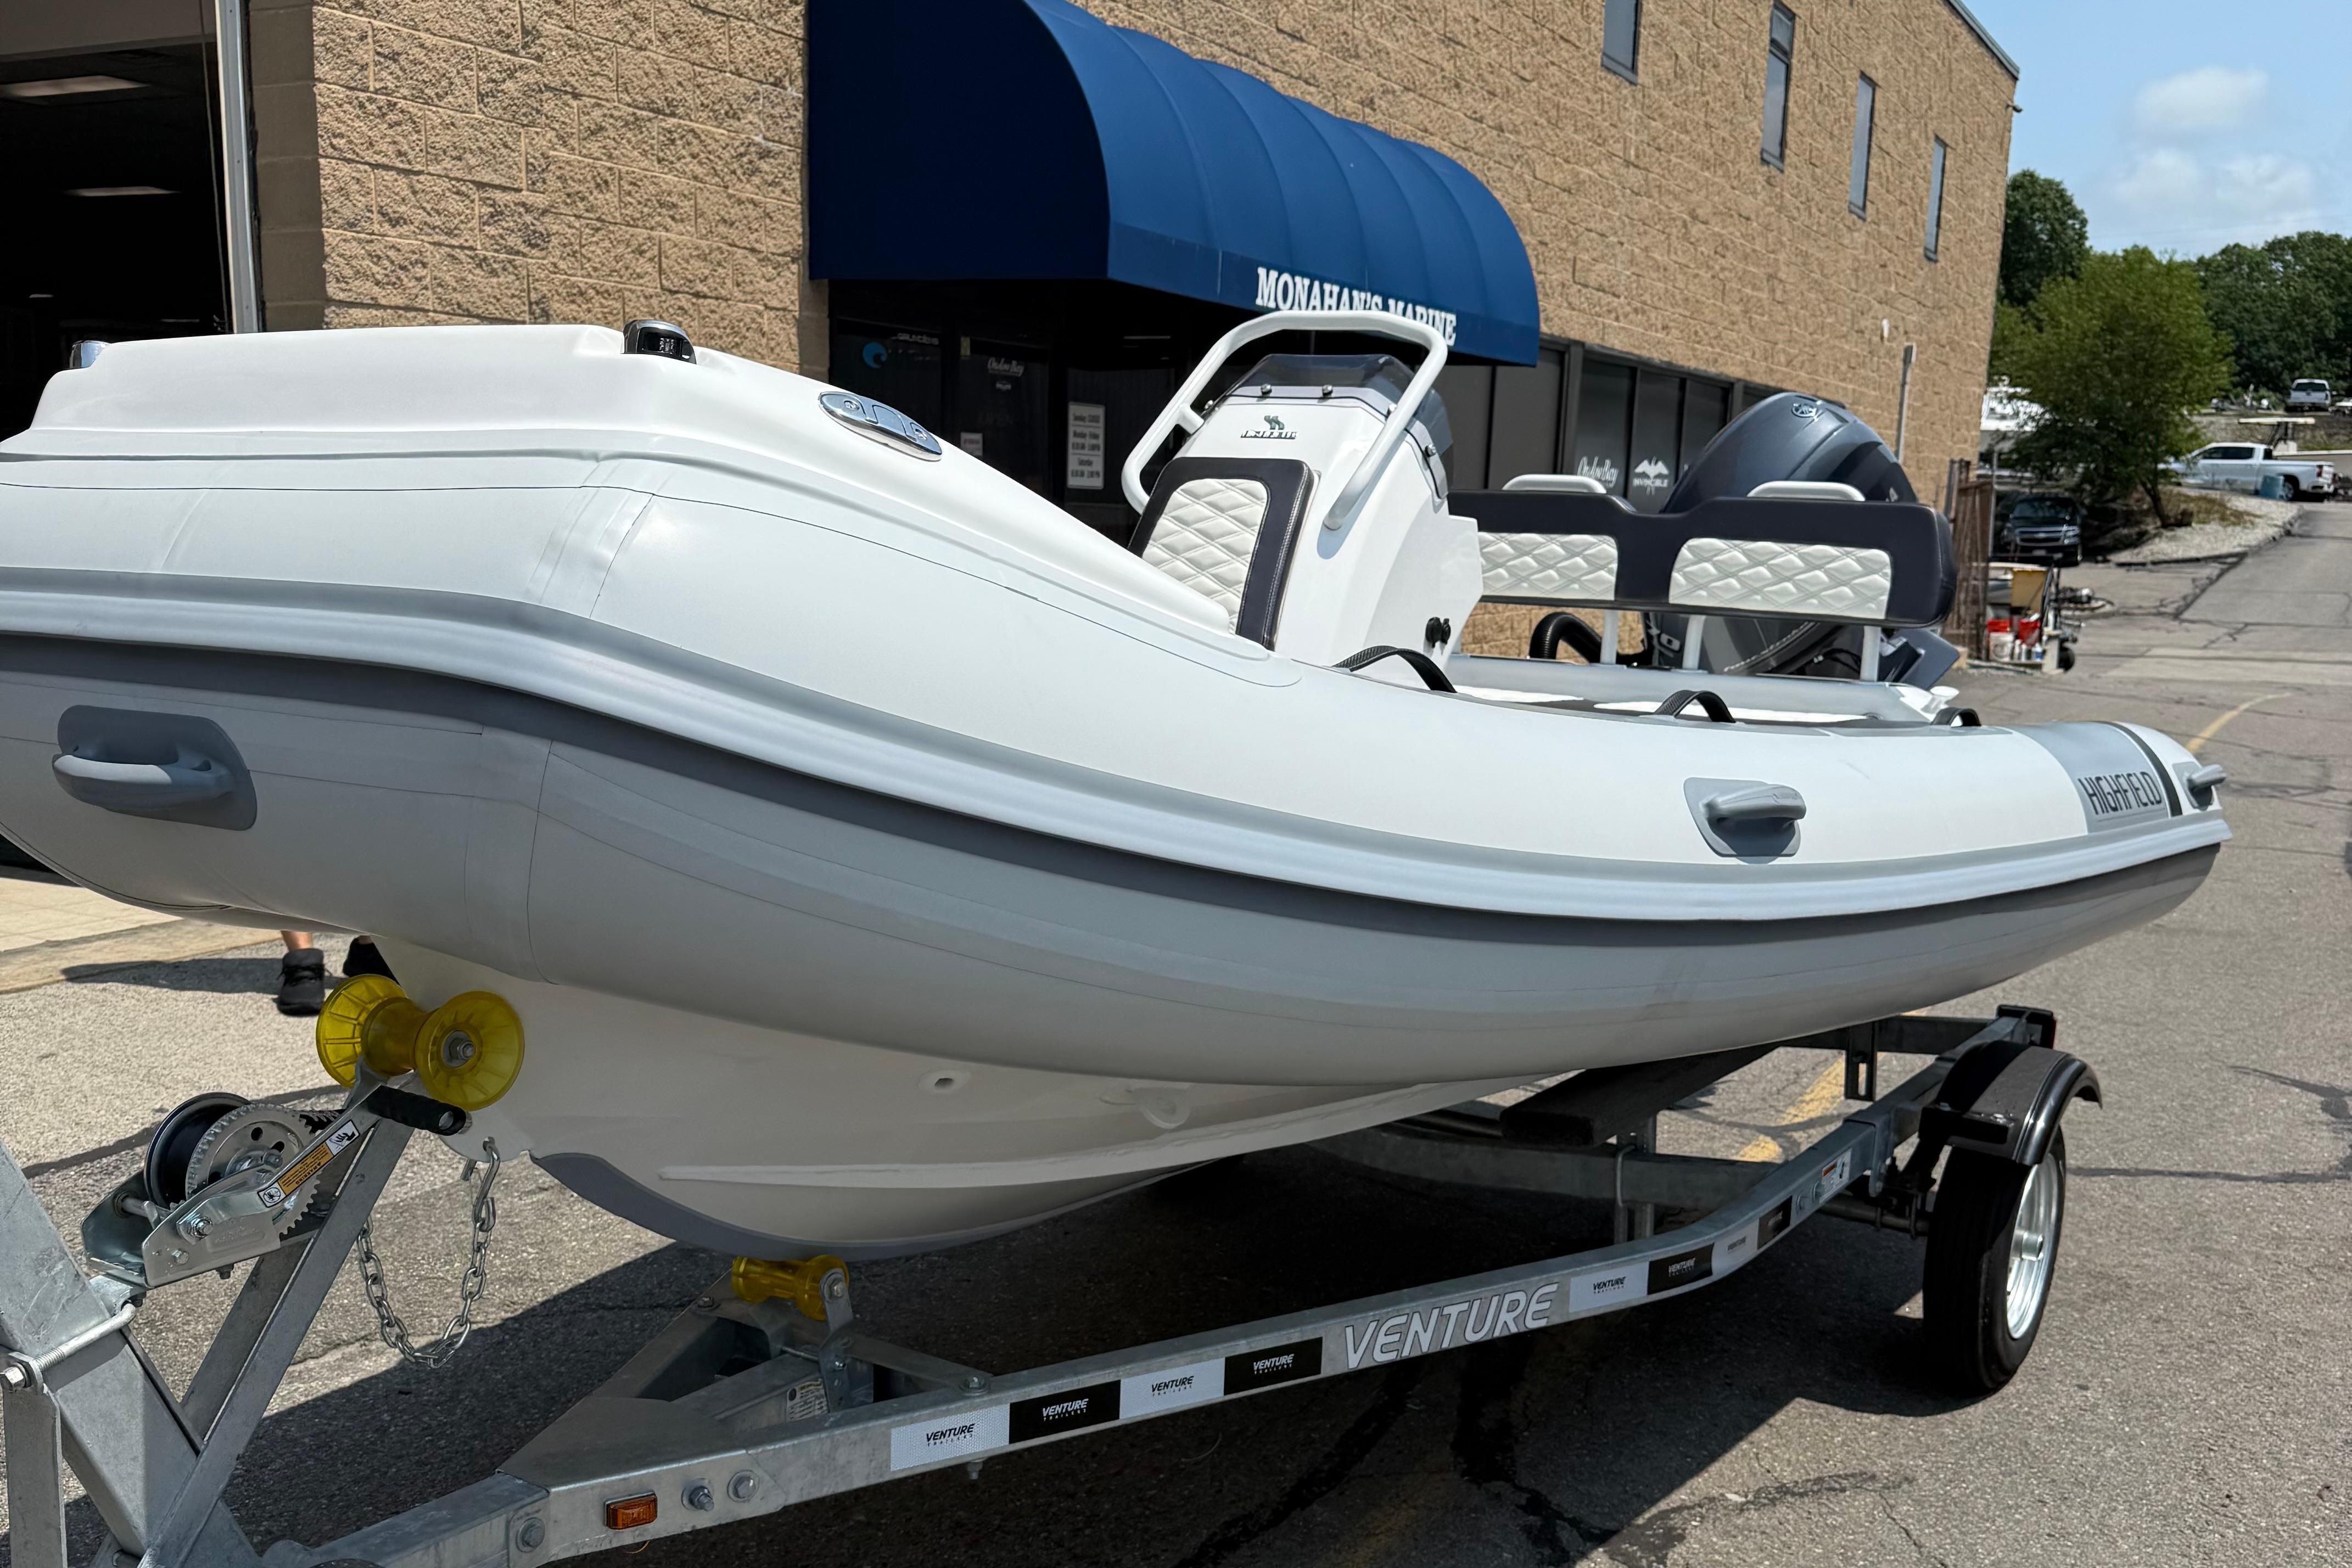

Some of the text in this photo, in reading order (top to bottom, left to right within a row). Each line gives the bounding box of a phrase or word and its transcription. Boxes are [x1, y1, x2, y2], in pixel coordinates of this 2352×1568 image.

[1256, 267, 1382, 312] MONAHAN'S
[1633, 478, 1668, 488] INVINCIBLE
[2077, 771, 2162, 815] HIGHFIELD
[1593, 1276, 1626, 1290] VENTURE
[1345, 1283, 1559, 1370] VENTURE
[1253, 1353, 1295, 1371] VENTURE
[1152, 1375, 1194, 1392] VENTURE
[1043, 1398, 1089, 1417] VENTURE
[926, 1423, 975, 1442] VENTURE
